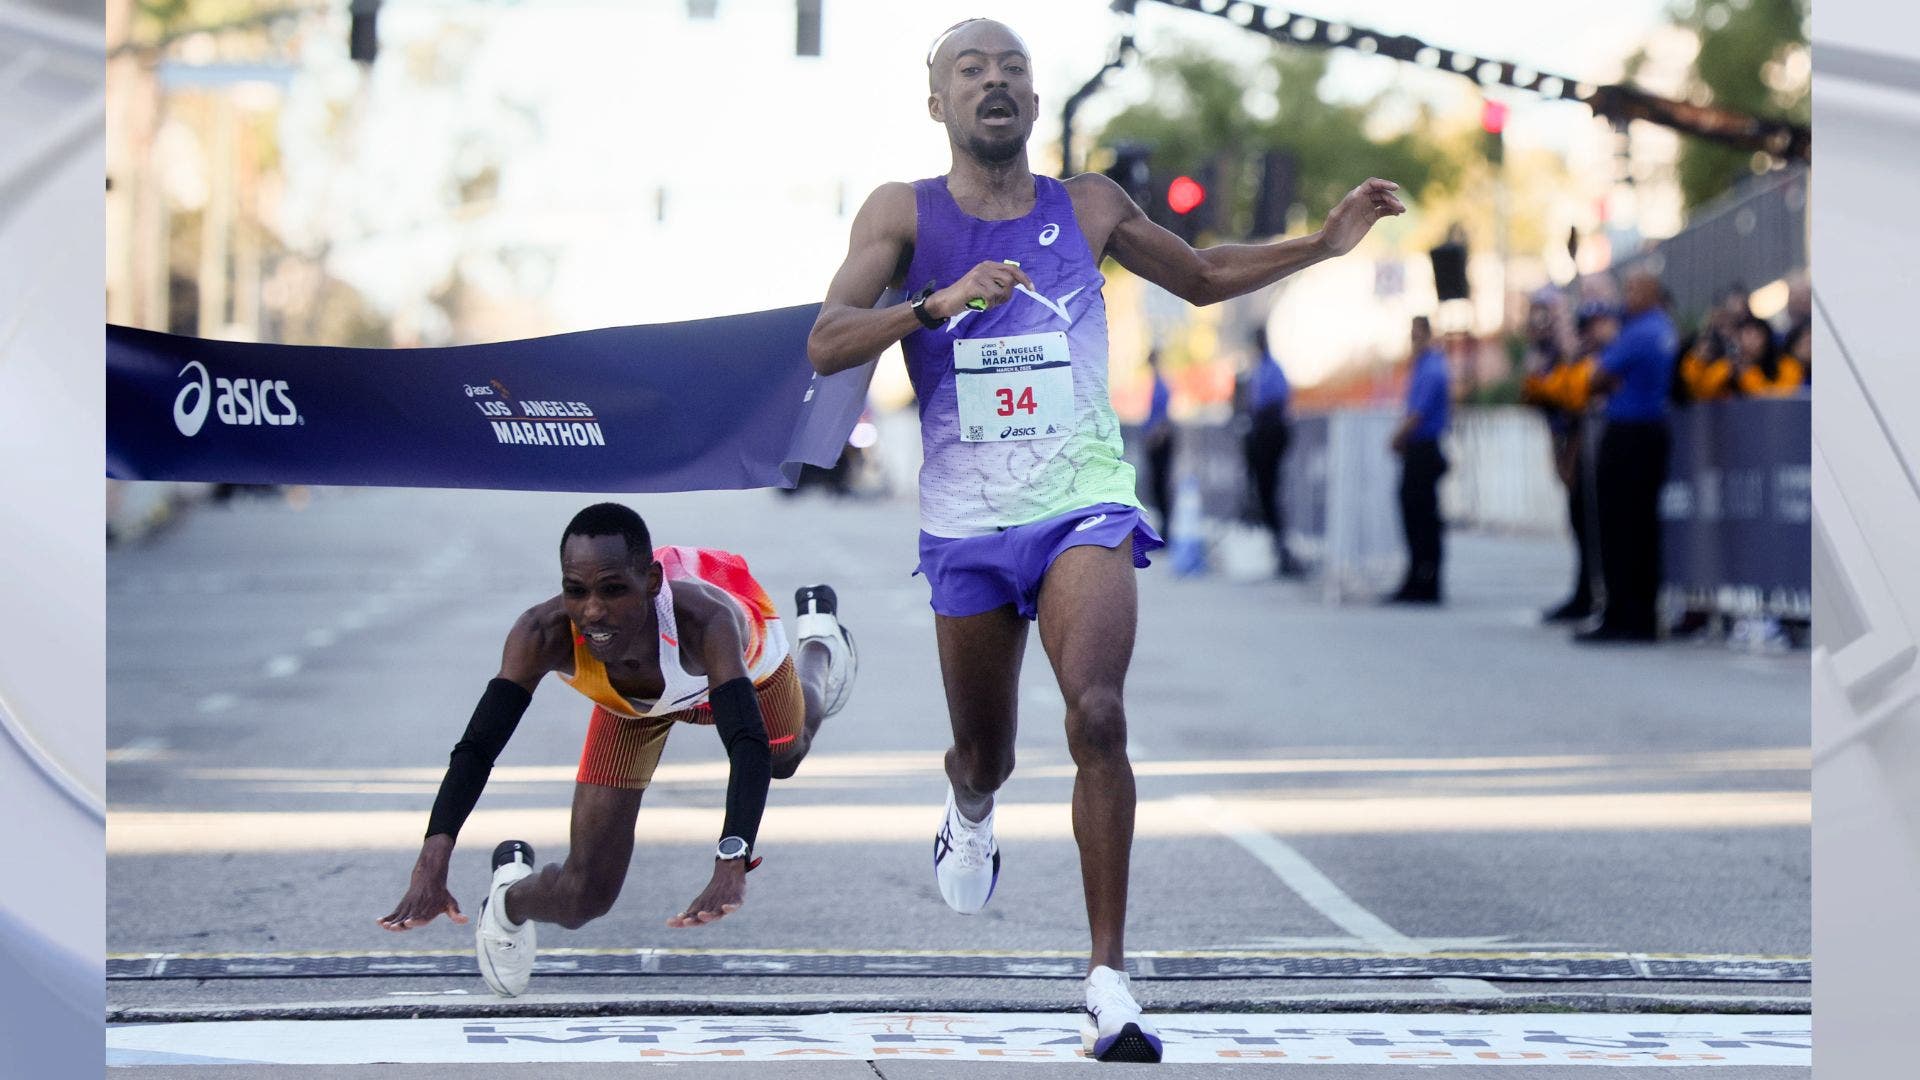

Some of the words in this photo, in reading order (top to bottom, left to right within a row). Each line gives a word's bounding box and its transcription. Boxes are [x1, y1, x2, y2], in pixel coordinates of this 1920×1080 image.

[1006, 345, 1043, 354] ANGELES
[982, 354, 1044, 366] MARATHON
[216, 378, 297, 425] asics
[996, 386, 1038, 416] 34
[475, 401, 512, 416] LOS
[520, 401, 594, 417] ANGELES
[491, 421, 605, 446] MARATHON
[463, 1026, 803, 1034] LOS
[640, 1048, 1092, 1058] MARC
